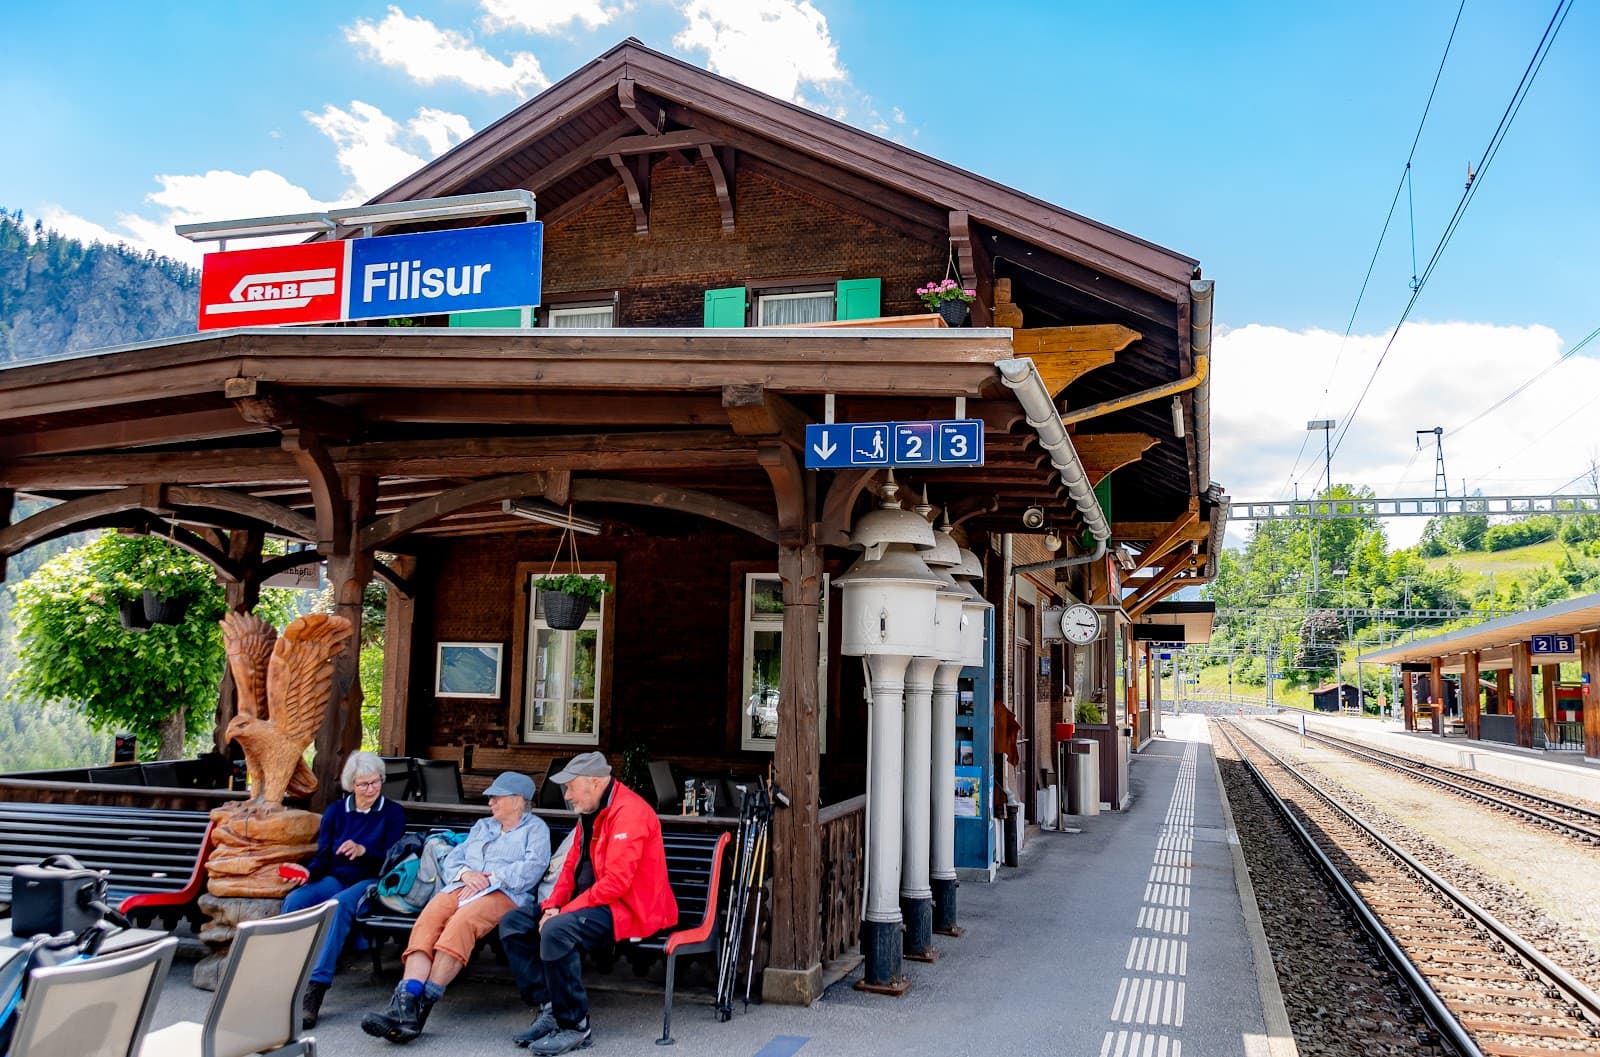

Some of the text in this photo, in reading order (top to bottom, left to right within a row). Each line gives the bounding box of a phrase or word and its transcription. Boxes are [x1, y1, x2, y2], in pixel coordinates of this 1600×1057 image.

[363, 260, 491, 302] Filisur
[247, 283, 298, 301] RhB
[906, 434, 967, 458] 2 3
[1538, 640, 1569, 651] 2 B
